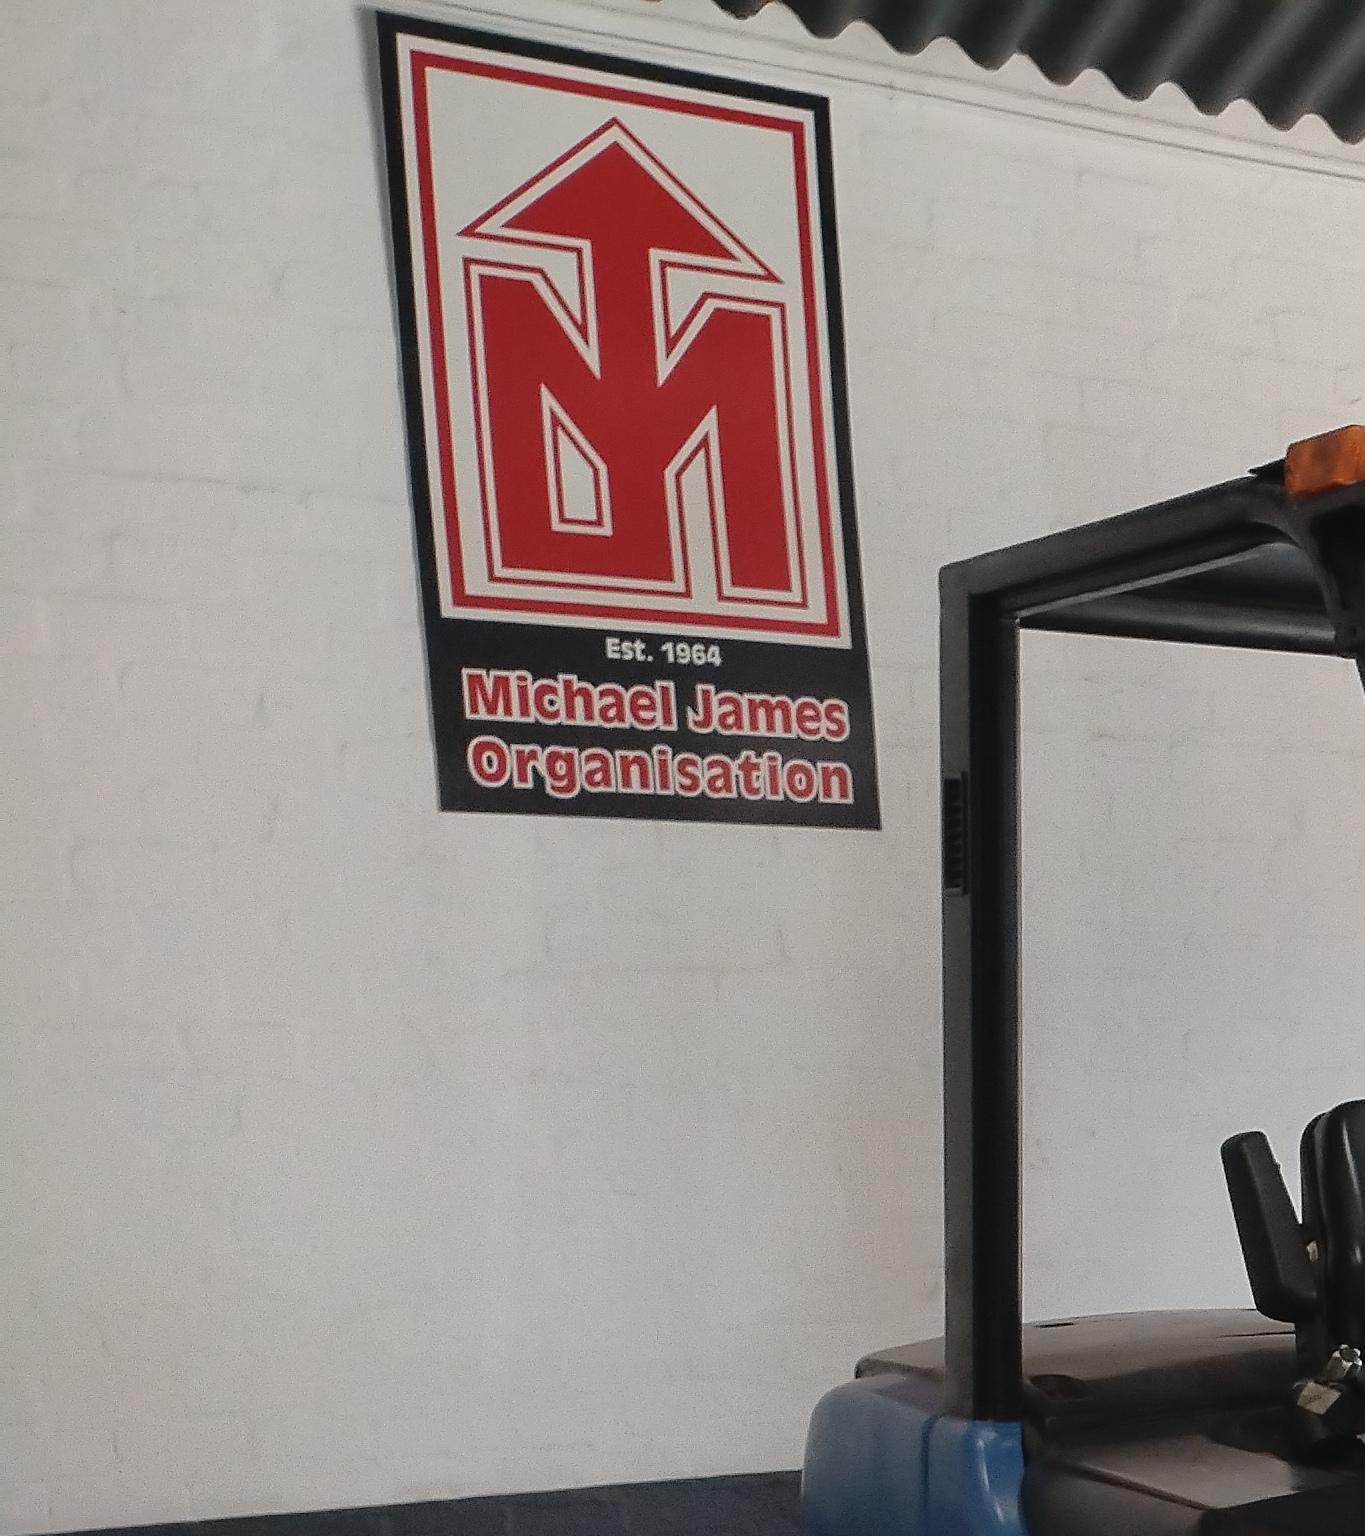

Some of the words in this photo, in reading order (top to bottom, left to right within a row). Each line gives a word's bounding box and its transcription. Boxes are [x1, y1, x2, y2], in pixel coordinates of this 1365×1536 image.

[605, 637, 654, 662] Est.
[661, 642, 722, 667] 1964
[461, 667, 678, 731] Michael
[688, 684, 851, 742] James
[467, 734, 854, 805] Organisation
